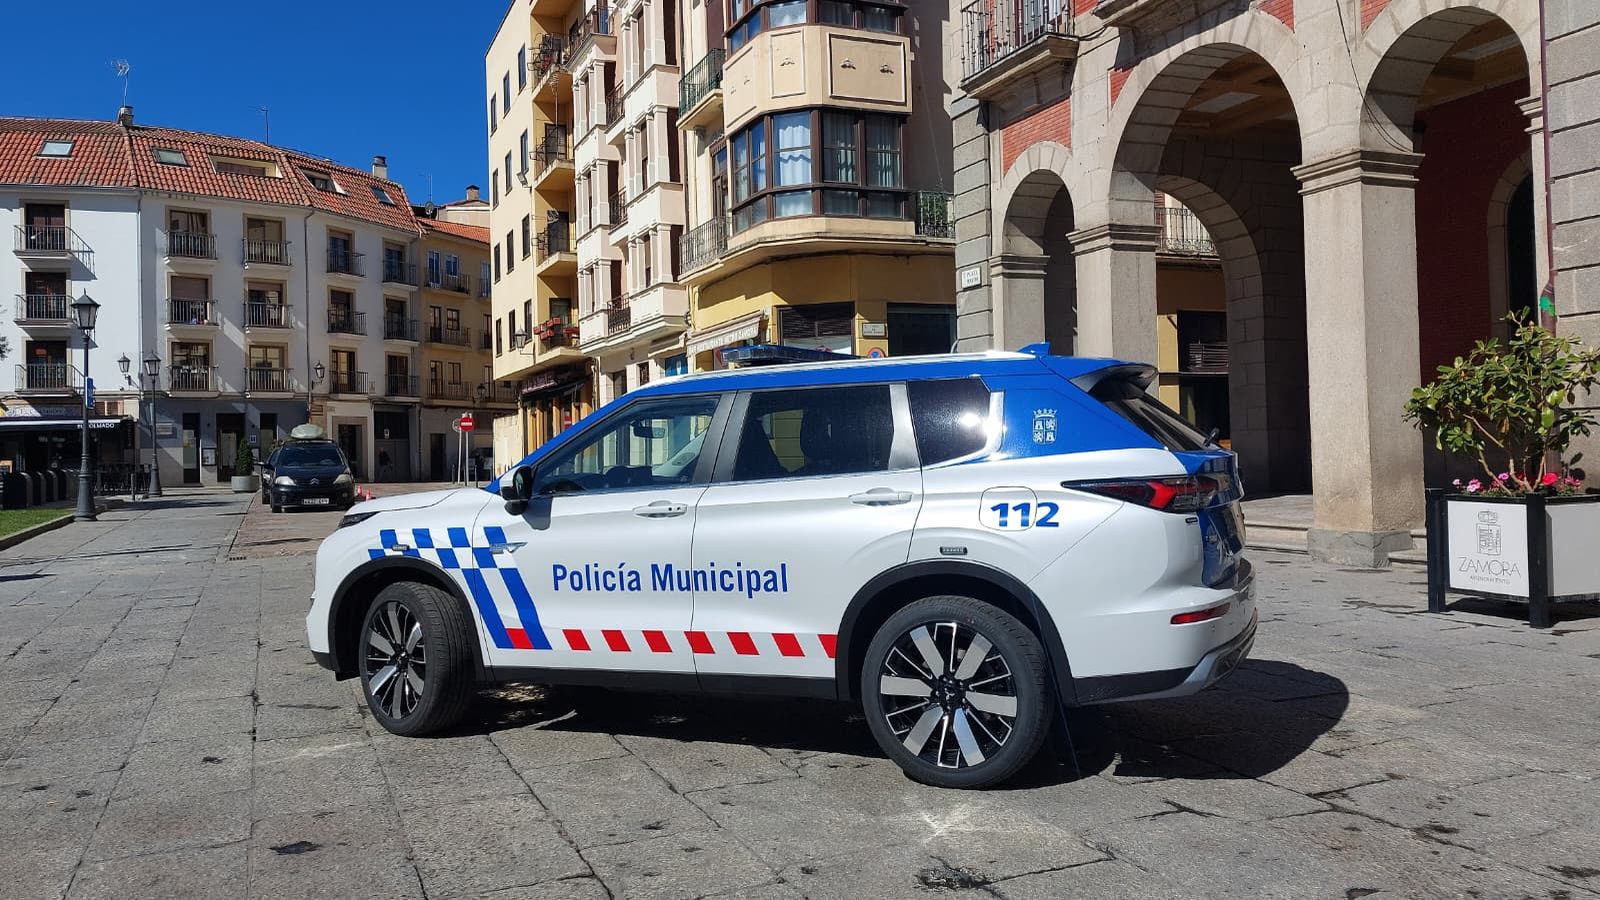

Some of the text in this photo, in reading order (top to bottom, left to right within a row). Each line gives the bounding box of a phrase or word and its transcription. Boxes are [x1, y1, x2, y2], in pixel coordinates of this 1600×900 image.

[990, 502, 1060, 527] 112
[1458, 557, 1521, 577] ZAMORA
[552, 562, 788, 599] Policía Municipal
